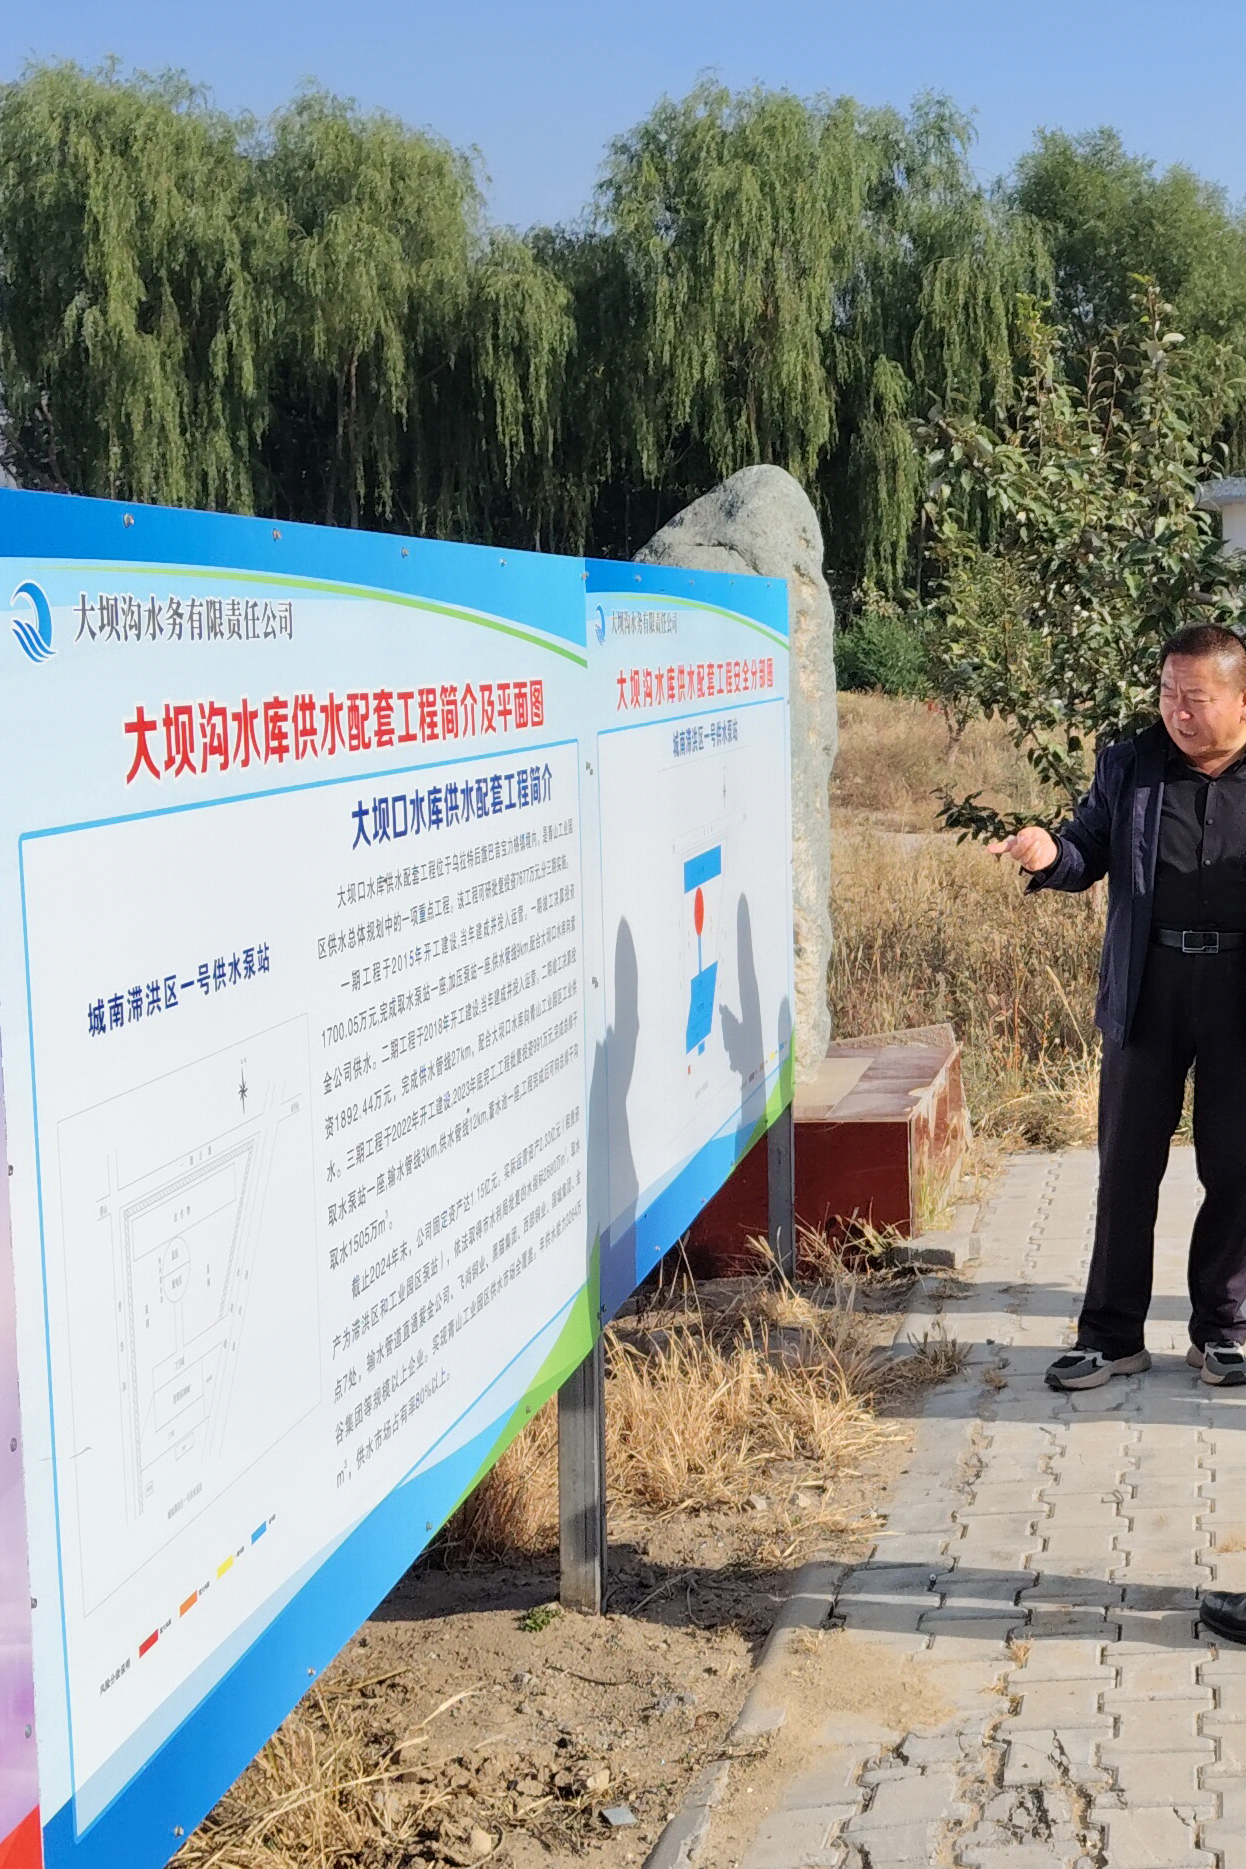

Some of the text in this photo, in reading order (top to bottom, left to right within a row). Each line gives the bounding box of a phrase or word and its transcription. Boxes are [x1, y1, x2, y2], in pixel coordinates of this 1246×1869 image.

[74, 592, 294, 642] 大坝沟水务有限责任公司
[617, 658, 774, 711] 大坝沟水库供水配套工程安全分部图
[124, 679, 545, 785] 大坝沟水库供水配套工程简介及平面图
[352, 765, 552, 850] 大坝口水库供水配套工程简介
[88, 942, 270, 1037] 城南滞洪区一号供水泵站
